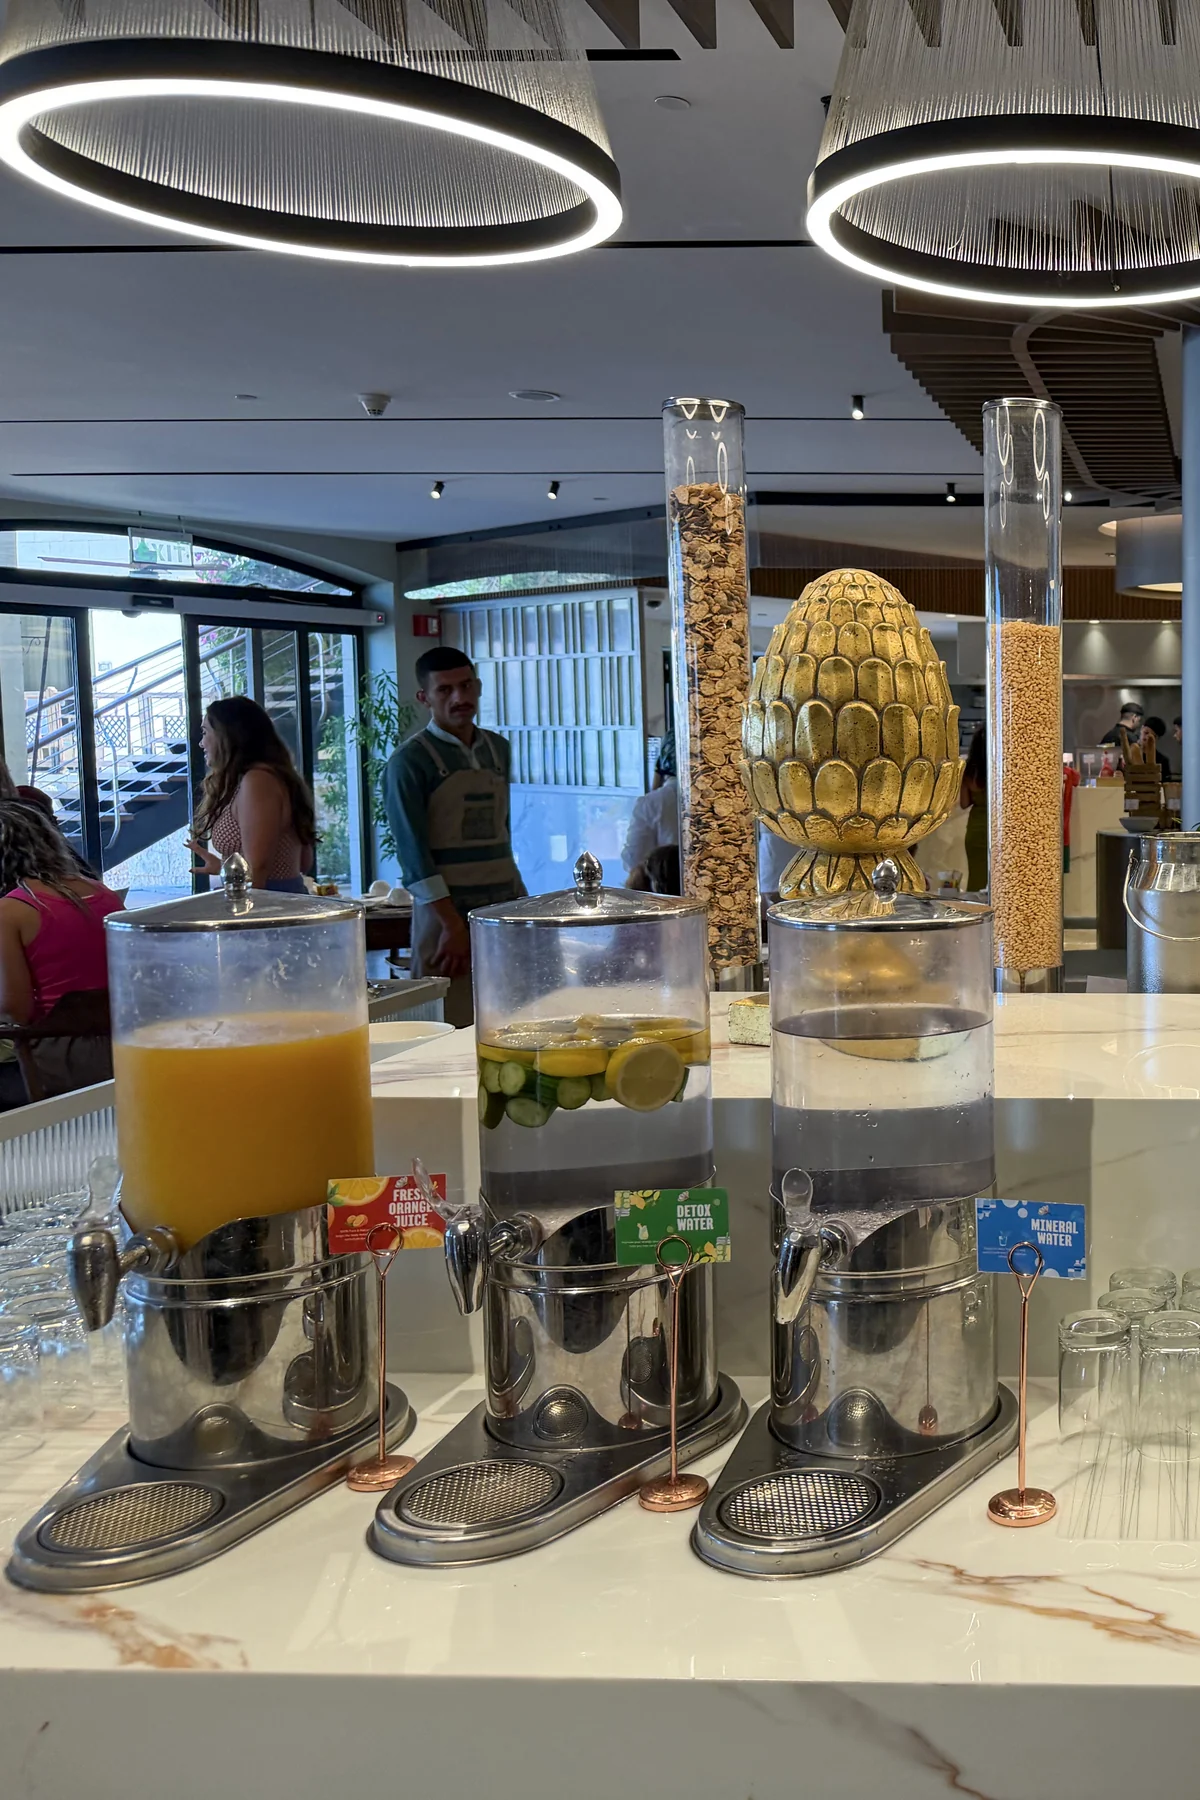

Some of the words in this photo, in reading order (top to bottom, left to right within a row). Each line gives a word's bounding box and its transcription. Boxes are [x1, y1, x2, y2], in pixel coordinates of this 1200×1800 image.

[676, 1203, 711, 1218] DETOX
[393, 1213, 429, 1227] JUICE
[676, 1217, 714, 1231] WATER
[1031, 1218, 1079, 1234] MINERAL
[1037, 1231, 1073, 1247] WATER
